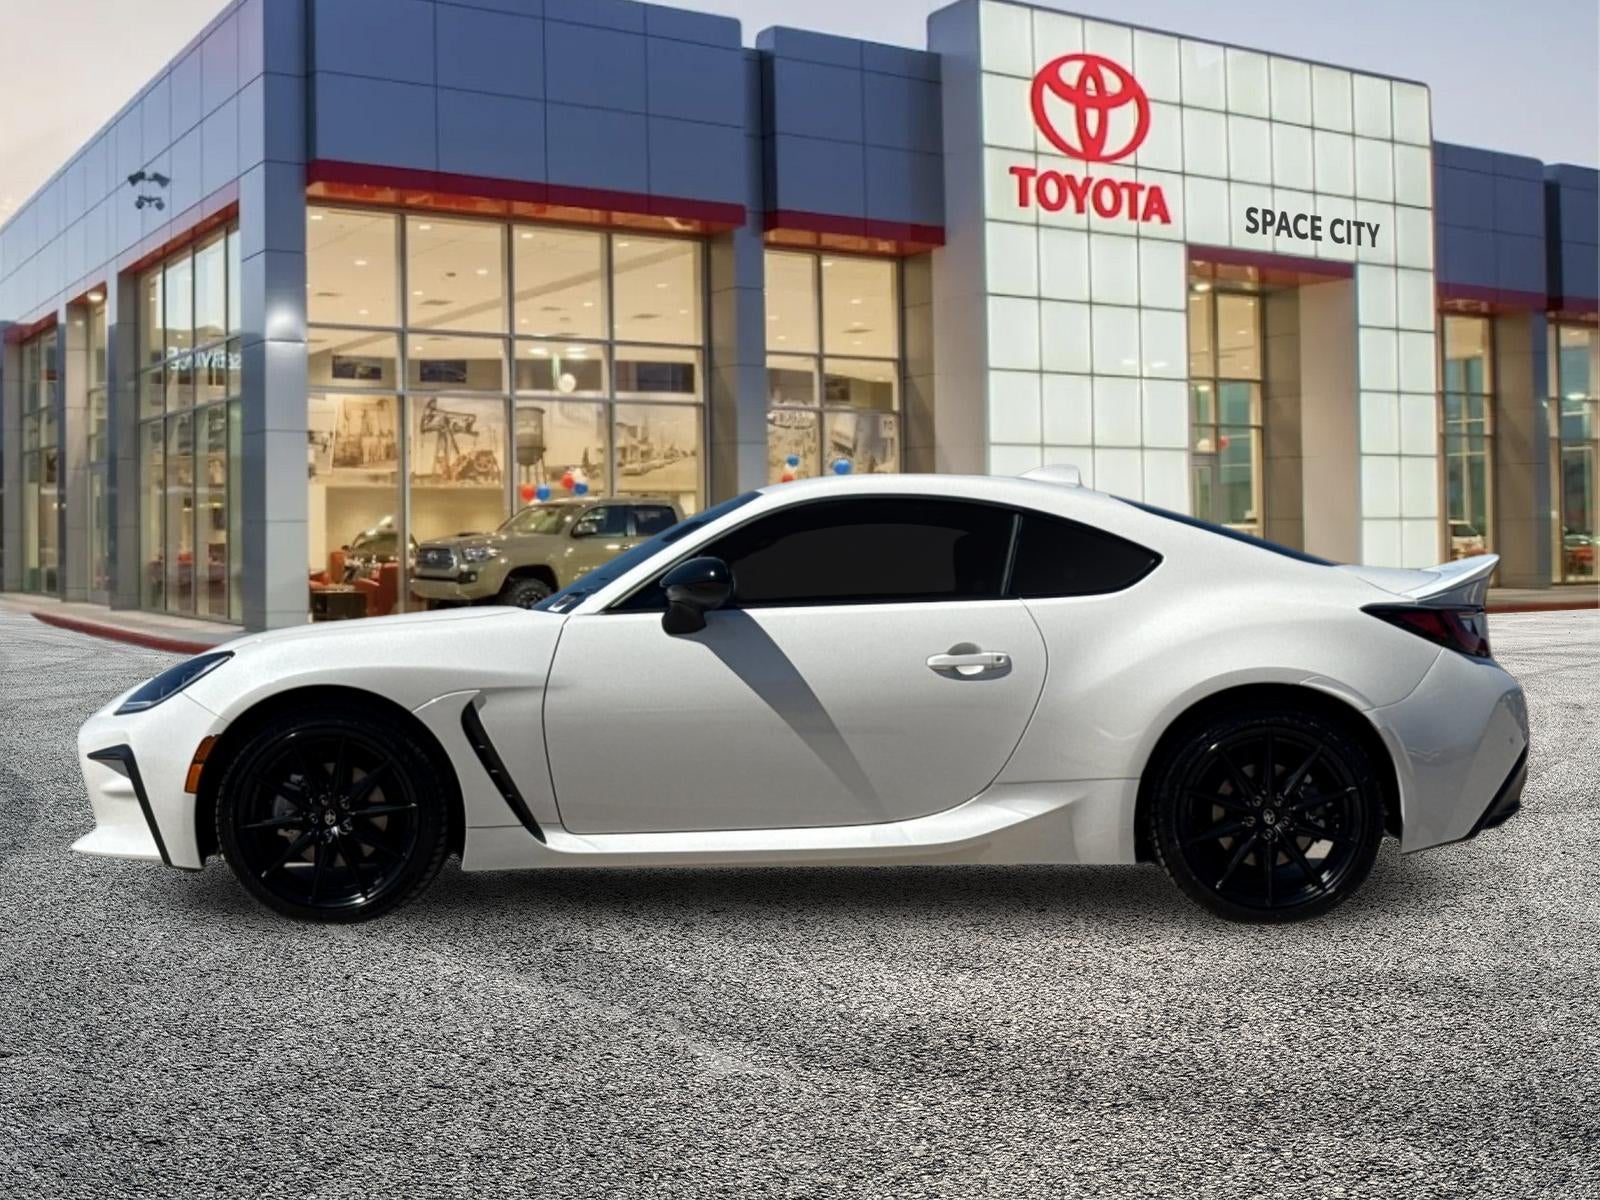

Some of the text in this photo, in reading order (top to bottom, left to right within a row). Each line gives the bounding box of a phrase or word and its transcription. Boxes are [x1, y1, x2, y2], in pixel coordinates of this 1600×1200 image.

[1009, 167, 1171, 224] TOYOTA
[1245, 207, 1380, 248] SPACE CITY
